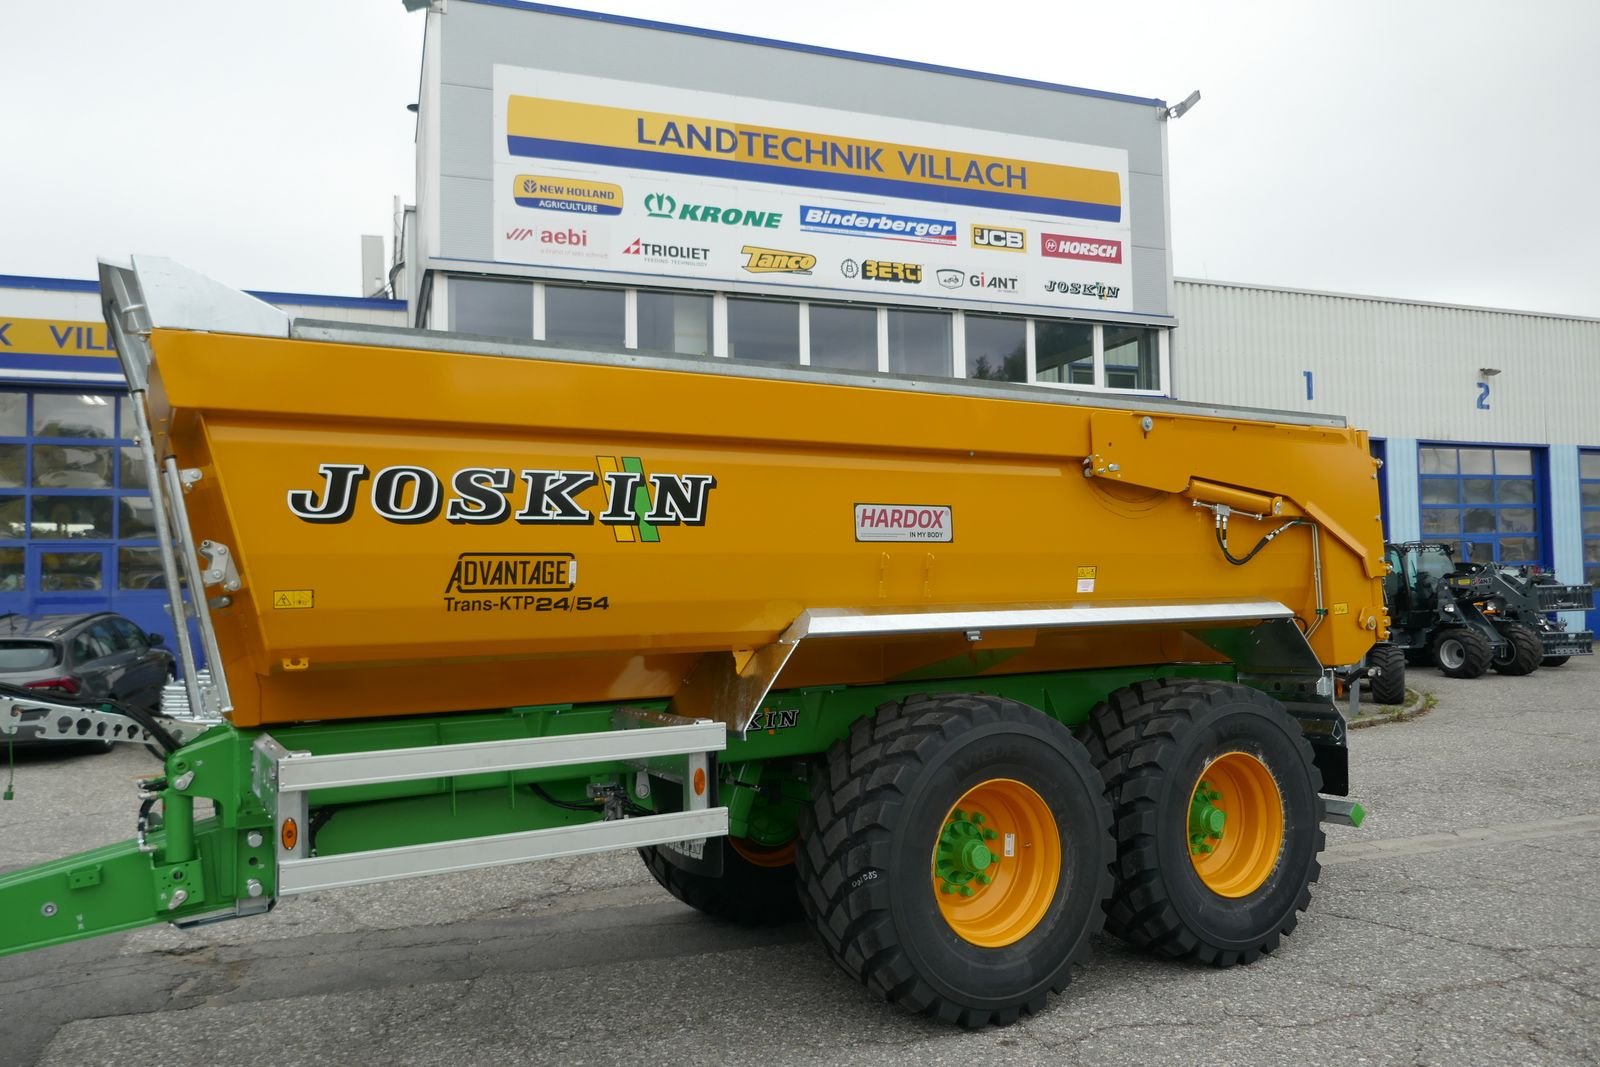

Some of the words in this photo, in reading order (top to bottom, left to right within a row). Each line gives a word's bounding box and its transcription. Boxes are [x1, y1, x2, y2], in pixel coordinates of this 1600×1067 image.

[637, 118, 884, 172] LANDTECHNIK
[898, 151, 1027, 190] VILLACH
[540, 184, 564, 195] NEW
[567, 187, 615, 200] HOLLAND
[539, 200, 598, 213] AGRICULTURE
[679, 204, 783, 229] KRONE
[805, 209, 953, 236] Binderberger
[541, 229, 587, 247] aebi
[975, 228, 1024, 248] JCB
[1058, 241, 1118, 258] HORSCH
[642, 243, 710, 260] TRIOLIET
[741, 246, 817, 273] Tanco
[1044, 280, 1120, 299] JOSKIN
[1303, 371, 1313, 400] 1
[1477, 382, 1490, 410] 2
[287, 464, 717, 526] JOSKIN
[861, 508, 944, 529] HARDOX
[445, 560, 566, 593] ADVANTAGE
